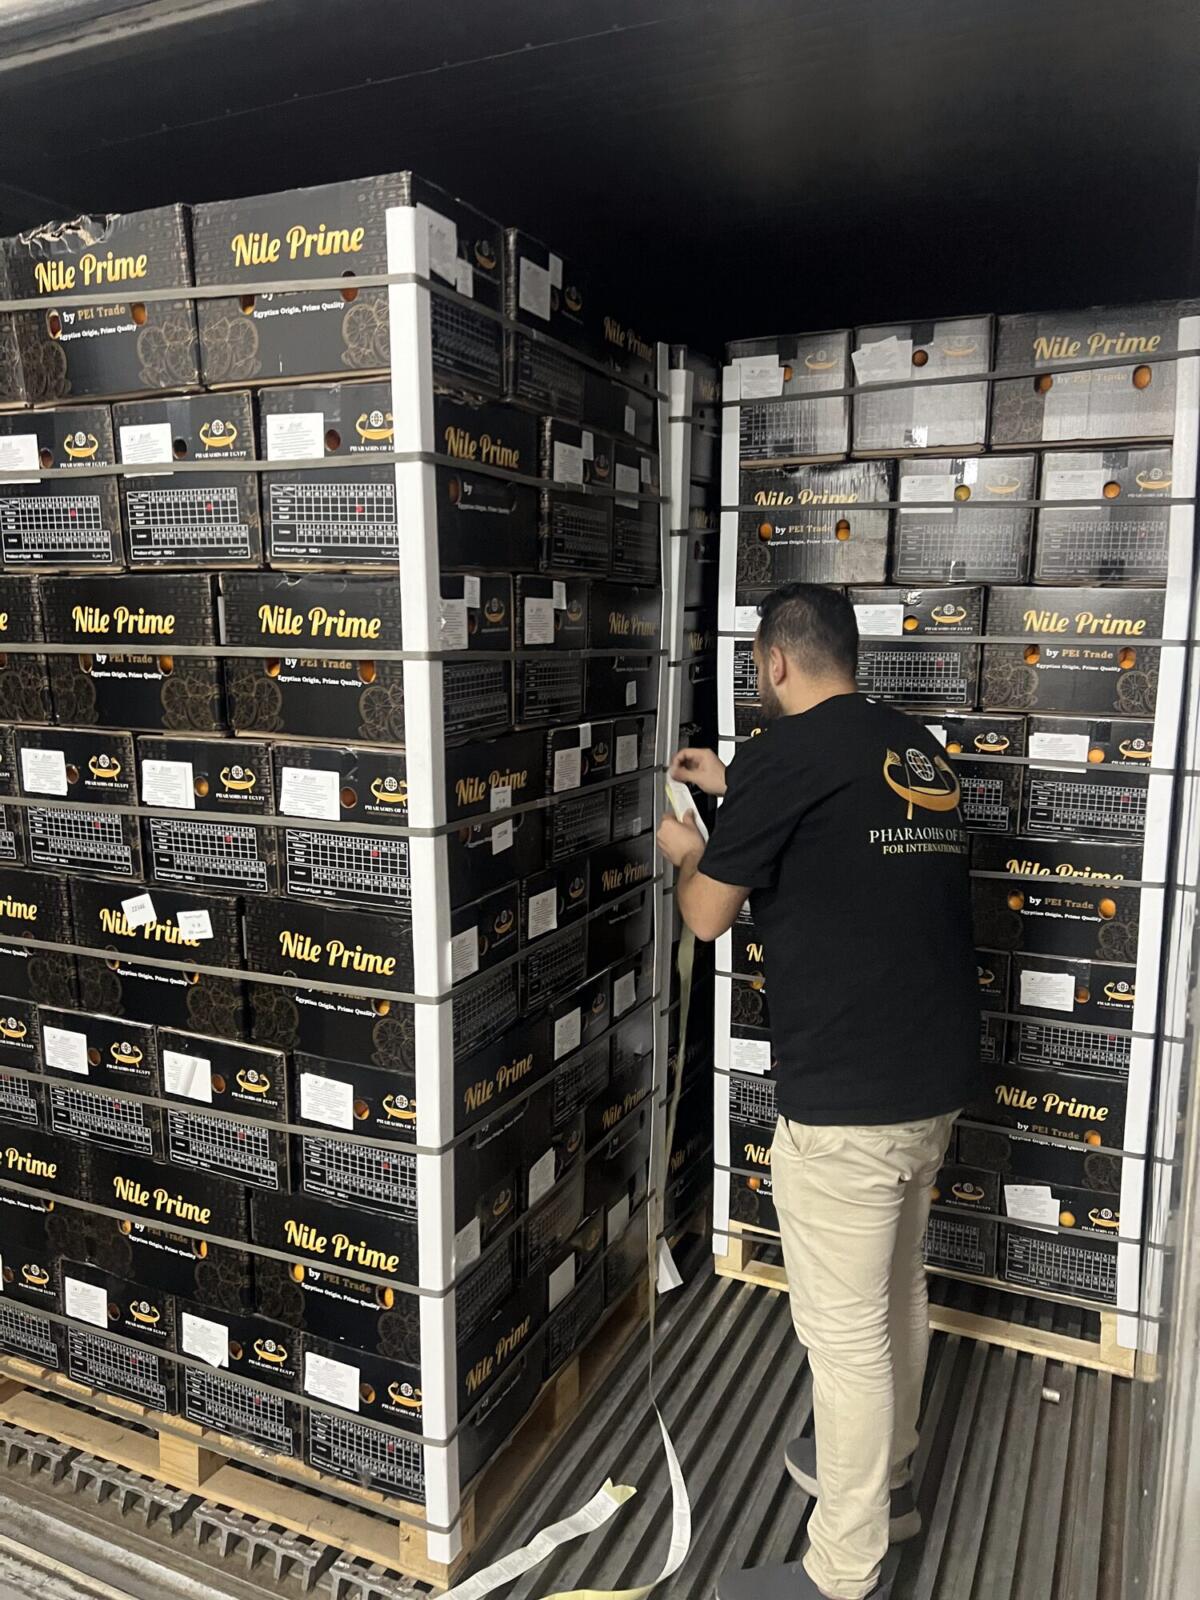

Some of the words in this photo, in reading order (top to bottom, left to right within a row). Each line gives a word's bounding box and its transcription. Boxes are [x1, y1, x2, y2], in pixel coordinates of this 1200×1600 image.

[231, 232, 281, 267] Nile
[286, 223, 365, 260] Prime
[35, 261, 75, 294] Nile
[80, 251, 147, 286] Prime
[63, 312, 75, 324] by
[97, 304, 125, 318] Trade
[1033, 336, 1080, 360] Nile
[1087, 331, 1161, 356] Prime
[445, 426, 477, 460] Nile
[479, 434, 519, 469] Prime
[775, 526, 786, 535] by
[72, 606, 110, 633] Nile
[113, 606, 175, 634] Prime
[258, 604, 303, 635] Nile
[308, 606, 381, 639] Prime
[1023, 609, 1069, 633] Nile
[1075, 611, 1146, 636] Prime
[1046, 648, 1059, 659] by
[1061, 649, 1079, 658] PEI
[1083, 650, 1113, 659] Trade
[456, 777, 486, 807] Nile
[869, 827, 944, 843] PHARAOHS
[883, 844, 904, 854] FOR
[0, 895, 37, 921] rime
[1029, 896, 1042, 906] by
[279, 930, 321, 963] Nile
[326, 940, 396, 975] Prime
[464, 1079, 493, 1115] Nile
[496, 1053, 533, 1093] Prime
[995, 1085, 1037, 1110] Nile
[1042, 1093, 1109, 1121] Prime
[1017, 1121, 1029, 1131] by
[5, 1147, 57, 1179] Prime
[744, 1143, 771, 1166] Nil
[113, 1176, 150, 1207] Nile
[153, 1188, 211, 1225] Prime
[284, 1220, 327, 1254] Nile
[331, 1234, 400, 1273] Prime
[308, 1268, 321, 1280] by
[466, 1356, 493, 1397] Nile
[496, 1315, 530, 1365] Prime
